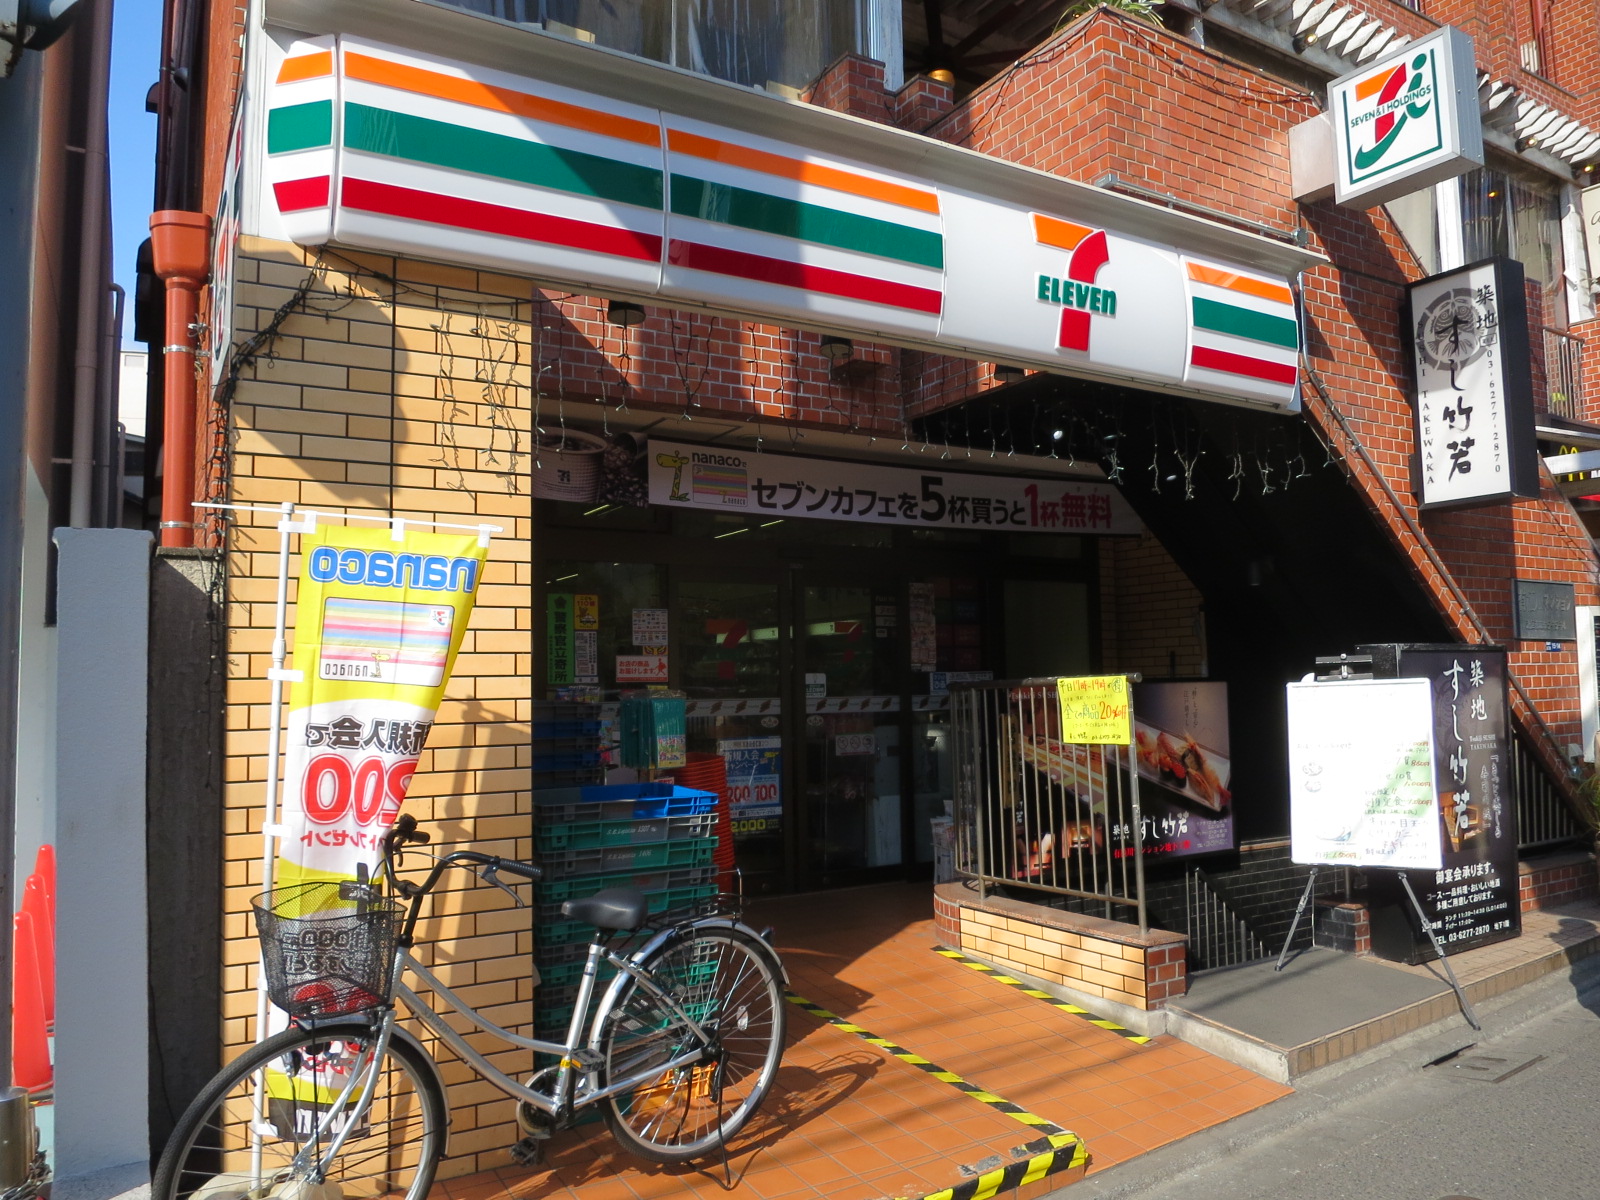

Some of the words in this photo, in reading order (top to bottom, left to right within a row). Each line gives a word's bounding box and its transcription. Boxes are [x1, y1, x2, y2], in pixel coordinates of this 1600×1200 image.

[1386, 85, 1431, 112] HOLDINGS
[1476, 284, 1498, 329] 築地
[1422, 390, 1435, 484] TAKEWAKA
[1487, 350, 1501, 473] 03-6277-2870
[1470, 659, 1487, 720] 築地
[1448, 924, 1490, 943] 03-6277-2870
